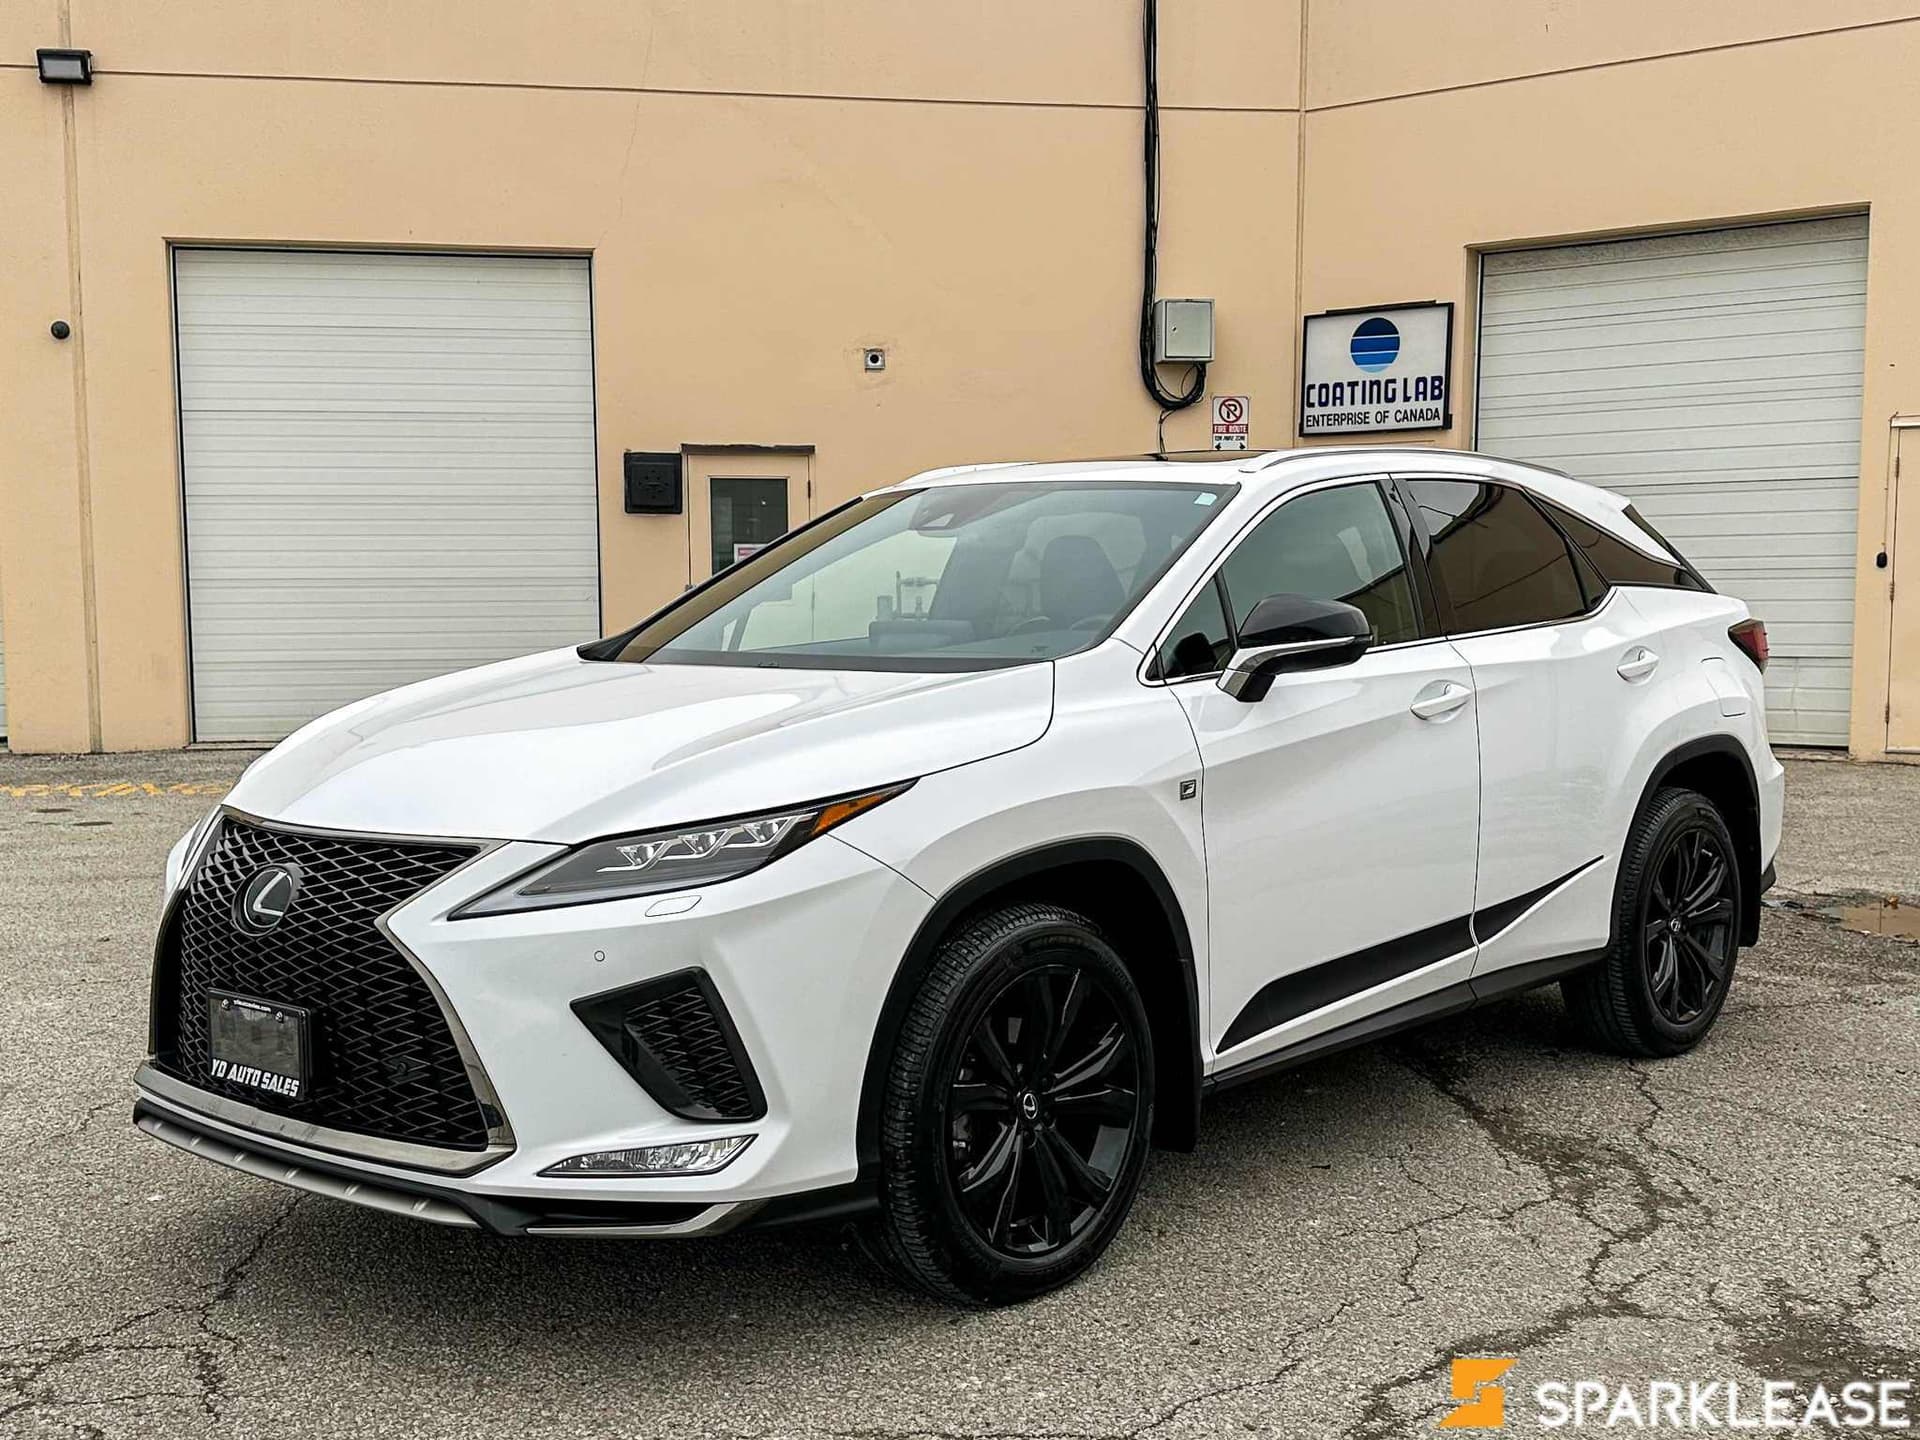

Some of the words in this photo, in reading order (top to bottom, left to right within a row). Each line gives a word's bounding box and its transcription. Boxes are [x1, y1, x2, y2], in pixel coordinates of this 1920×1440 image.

[1306, 379, 1396, 408] COATING
[1402, 375, 1443, 402] LAB
[1306, 411, 1370, 427] ENTERPRISE
[1375, 410, 1389, 424] OF
[1394, 408, 1440, 423] CANADA
[226, 1064, 262, 1087] AUTO
[260, 1072, 300, 1097] SALES
